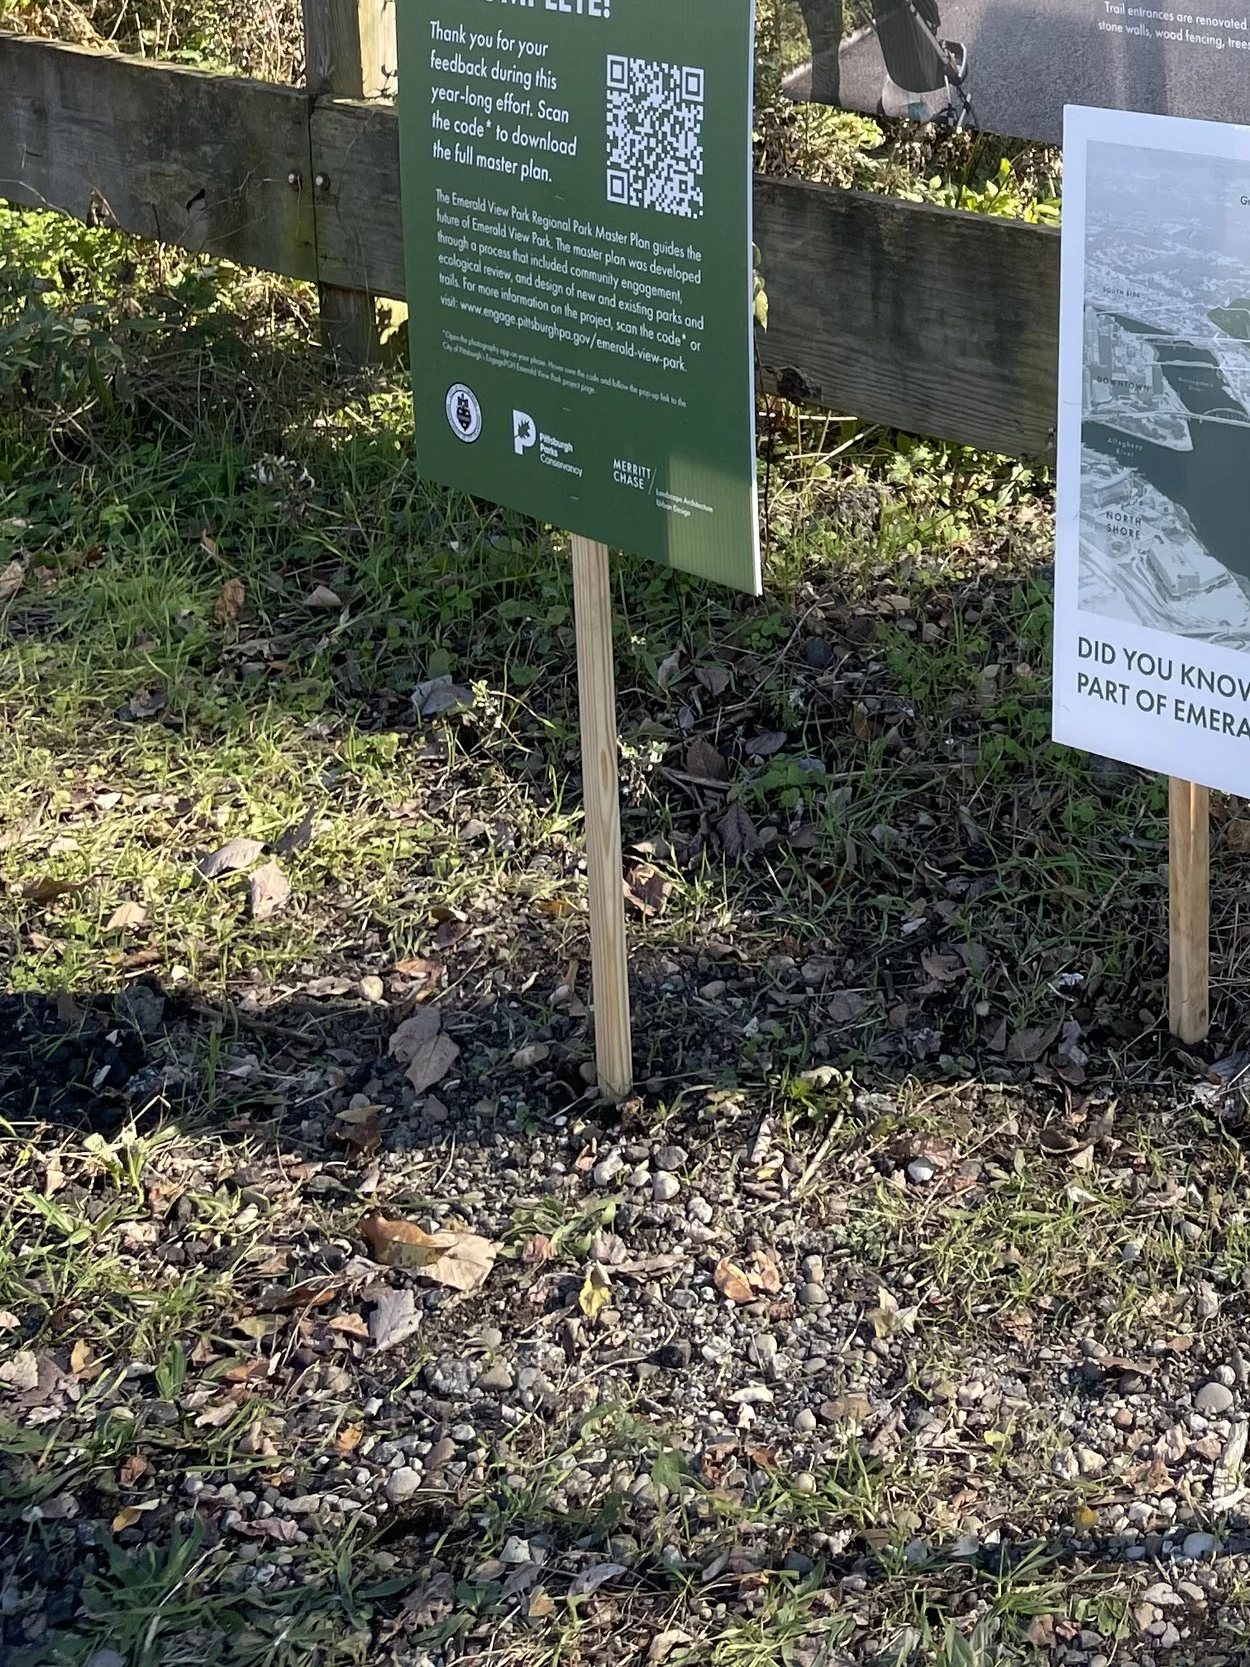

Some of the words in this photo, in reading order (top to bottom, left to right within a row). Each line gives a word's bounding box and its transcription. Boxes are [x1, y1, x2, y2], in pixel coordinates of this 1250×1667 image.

[1103, 0, 1125, 14] Trail
[1127, 6, 1174, 21] entrances
[1176, 13, 1193, 24] are
[1195, 15, 1247, 30] renovated
[429, 19, 466, 44] Thank
[468, 32, 493, 51] you
[496, 29, 515, 51] for
[517, 40, 549, 58] your
[1097, 19, 1123, 33] stone
[1124, 23, 1152, 38] walls,
[1155, 28, 1183, 41] wood
[1185, 28, 1225, 50] fencing,
[430, 48, 487, 78] feedback
[490, 59, 532, 91] during
[534, 66, 557, 90] this
[430, 85, 492, 114] year-long
[495, 91, 533, 117] effort.
[536, 99, 569, 123] Scan
[431, 109, 450, 131] the
[495, 124, 508, 142] to
[511, 124, 577, 156] download
[432, 138, 451, 160] the
[454, 142, 473, 165] full
[476, 154, 518, 174] master
[520, 157, 552, 182] plan.
[440, 296, 460, 308] visit:
[539, 432, 573, 453] Pittsburgh
[540, 443, 559, 458] Parks
[540, 453, 583, 478] Conservancy
[613, 458, 652, 479] MERRITT
[613, 470, 645, 490] CHASE
[1106, 511, 1142, 526] NORTH
[1106, 525, 1141, 540] SHORE
[1077, 635, 1116, 665] DID
[1123, 647, 1172, 681] YOU
[1077, 671, 1130, 705] PART
[1135, 688, 1167, 715] OF
